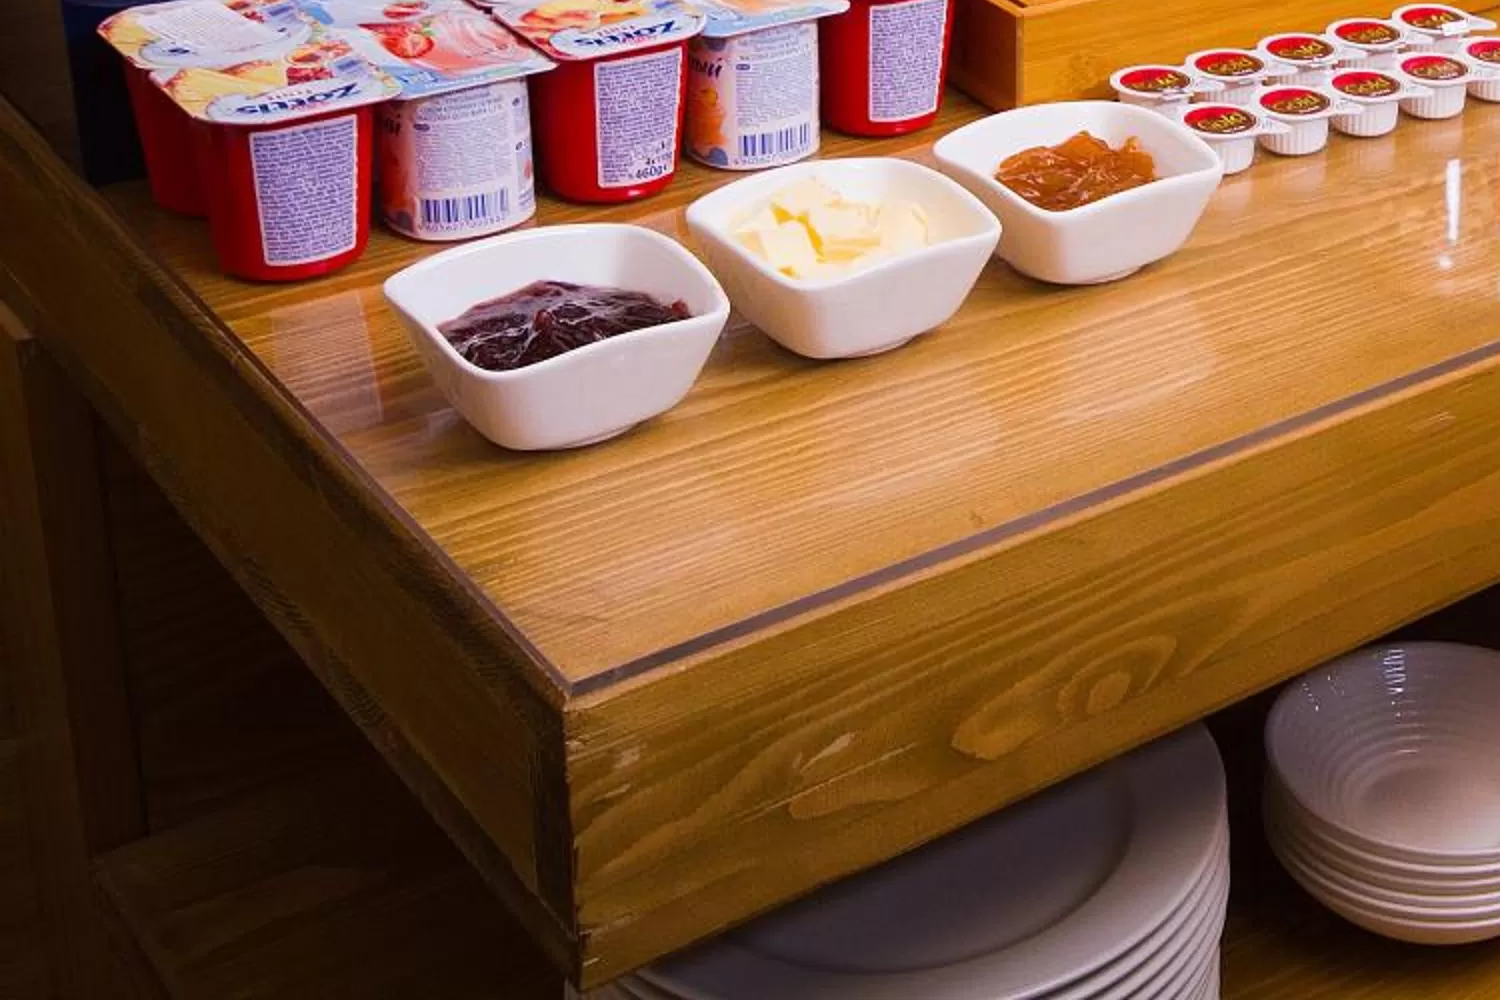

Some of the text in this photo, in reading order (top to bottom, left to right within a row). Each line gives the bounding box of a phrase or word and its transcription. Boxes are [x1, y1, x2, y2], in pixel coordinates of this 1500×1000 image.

[1208, 56, 1254, 73] Gold
[1345, 77, 1391, 95] Gold
[1197, 111, 1247, 130] Gold
